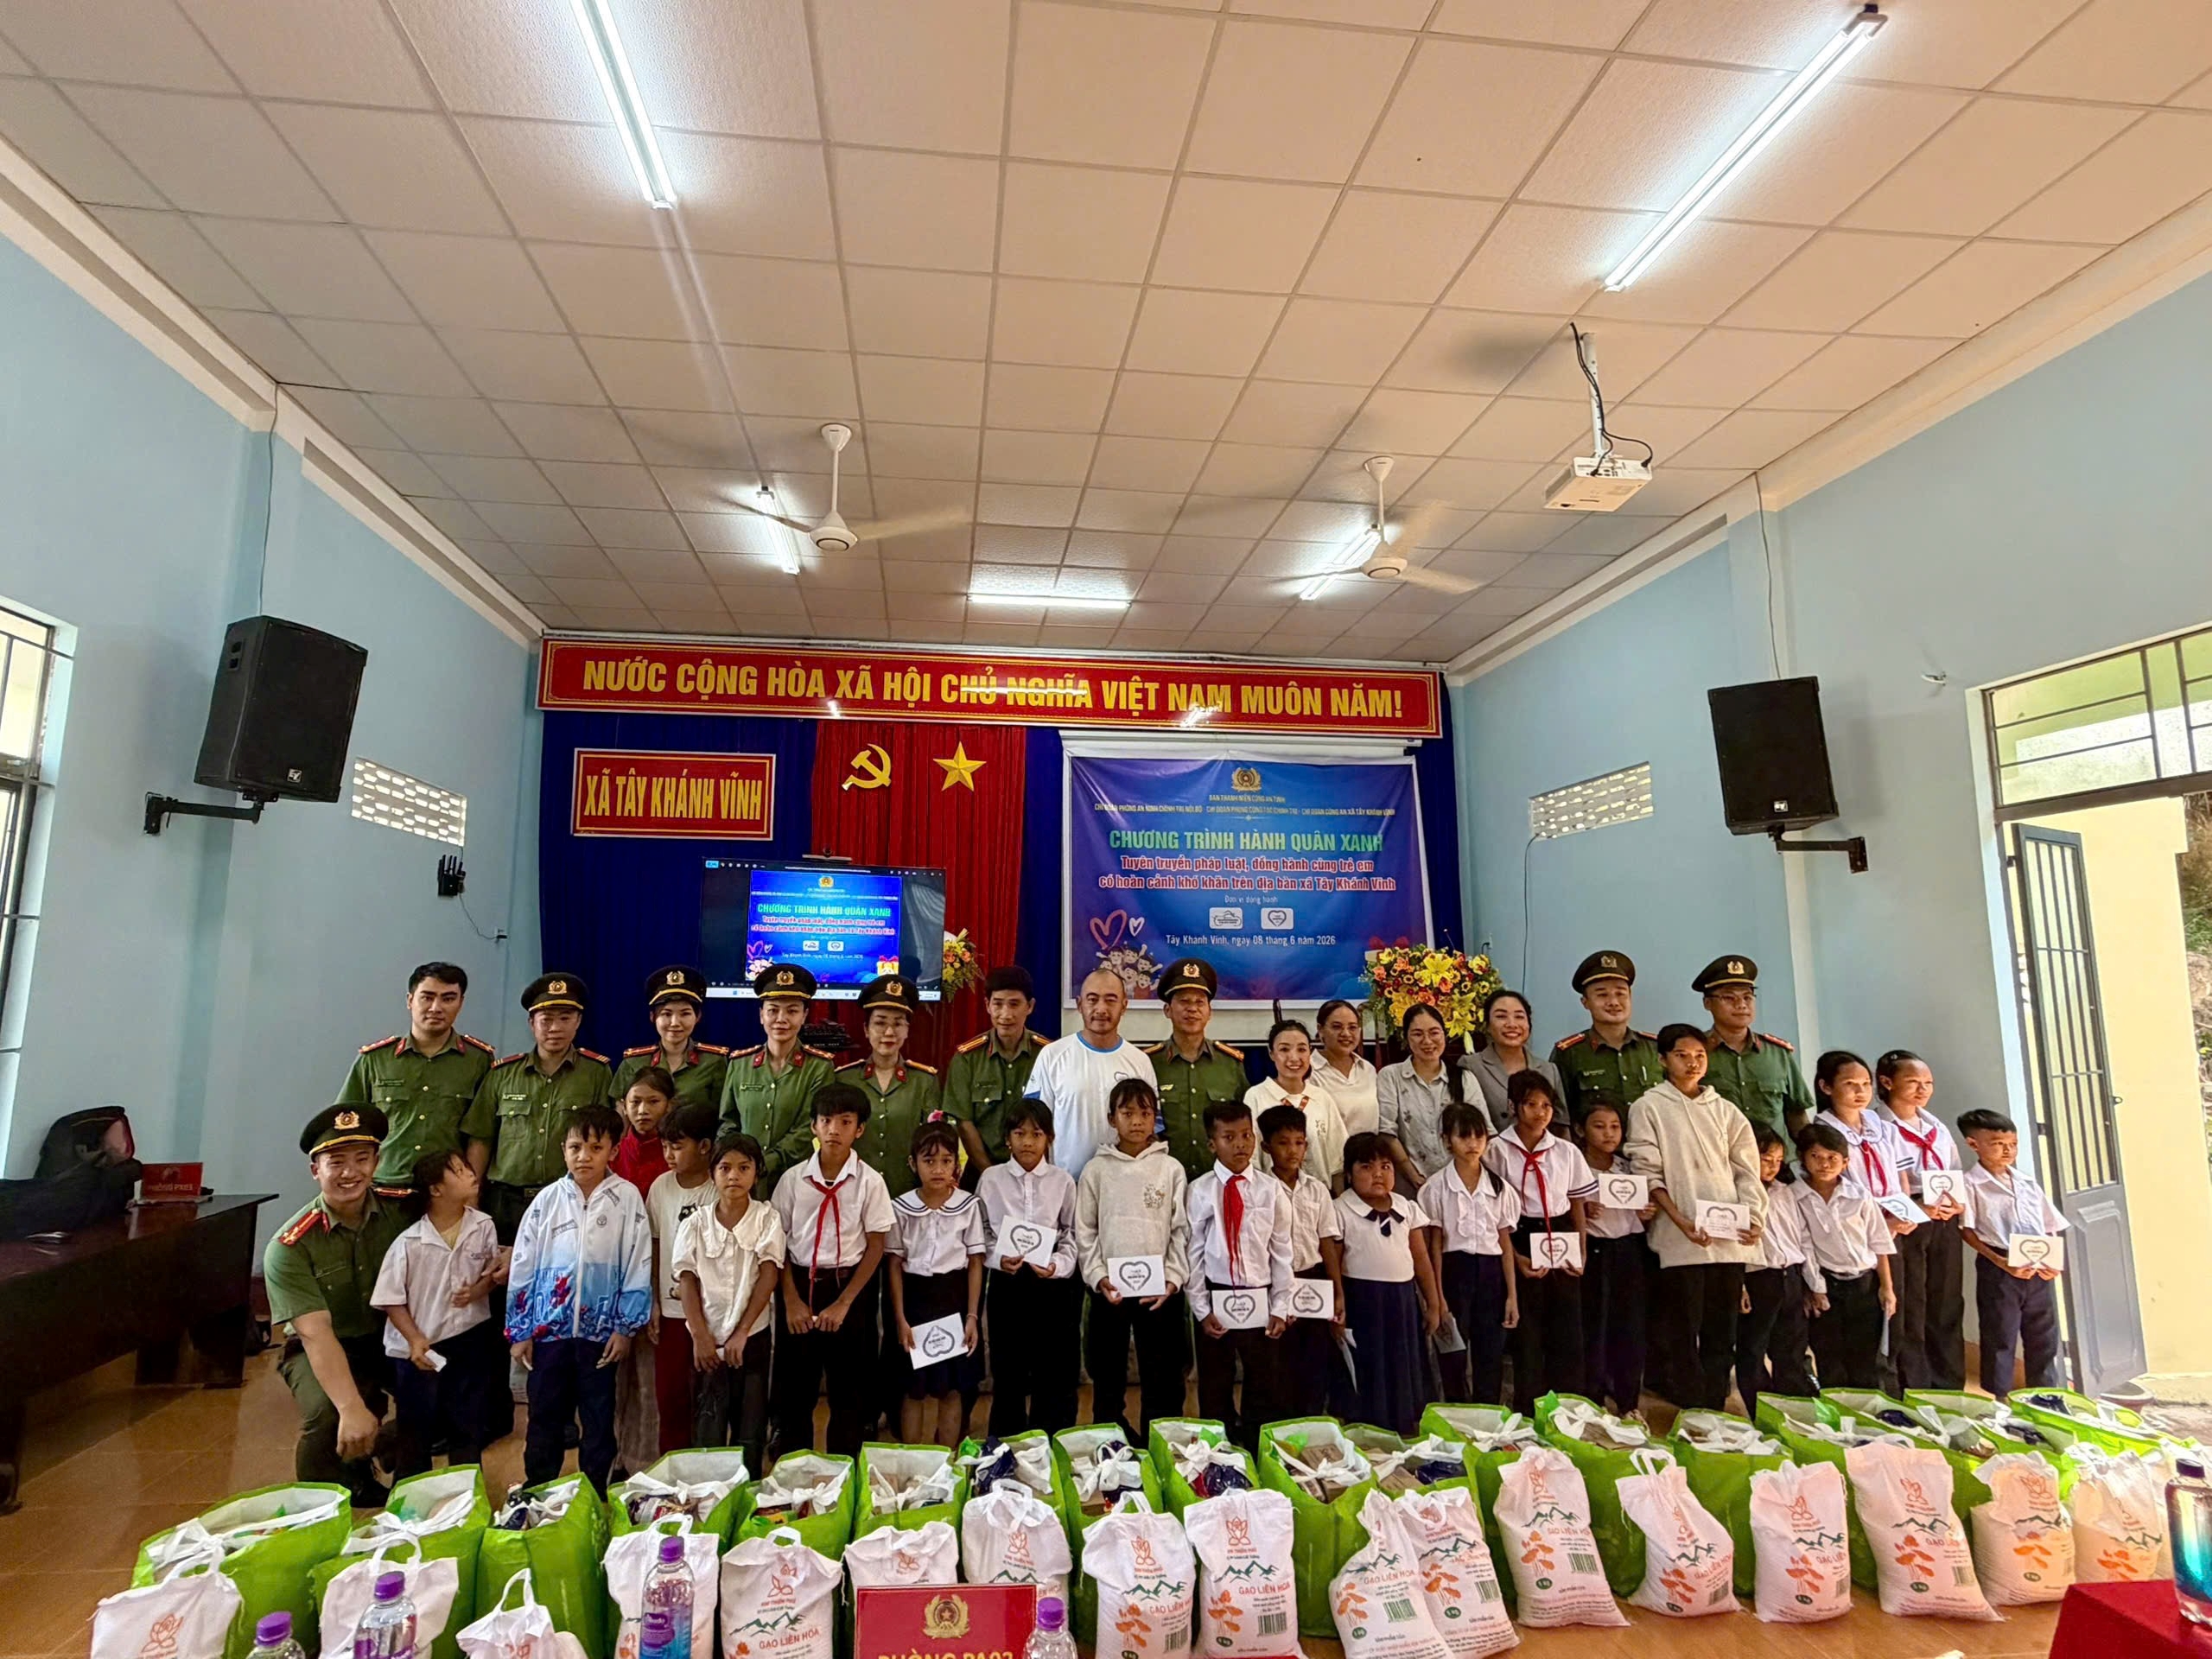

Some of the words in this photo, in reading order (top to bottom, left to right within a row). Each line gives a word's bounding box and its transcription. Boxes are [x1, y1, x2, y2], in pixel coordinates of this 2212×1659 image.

[583, 656, 667, 692] NƯỚC
[676, 658, 758, 701] CỘNG
[766, 661, 823, 699] HÒA
[835, 664, 874, 700] XÃ
[883, 666, 931, 708] HỘI
[941, 666, 997, 706] CHỦ
[1007, 673, 1093, 709] NGHĨA
[1102, 676, 1160, 716] VIỆT
[1168, 683, 1231, 713] NAM
[1241, 681, 1322, 716] MUÔN
[1331, 683, 1402, 719] NĂM!
[584, 768, 611, 817] XÃ
[615, 767, 647, 817] TÂY
[650, 768, 715, 819] KHÁNH
[720, 771, 763, 821] VĨNH
[1109, 830, 1179, 849] CHƯƠNG
[1184, 828, 1235, 850] TRÌNH
[1239, 829, 1287, 851] HÀNH
[1291, 830, 1337, 853] QUÂN
[1340, 833, 1382, 852] XANH
[1121, 855, 1153, 871] Tuyên
[1156, 854, 1191, 871] truyền
[1194, 856, 1222, 872] pháp
[1282, 857, 1310, 872] hành
[1312, 858, 1338, 874] cùng
[1357, 860, 1375, 873] em
[1099, 874, 1115, 888] có
[1116, 874, 1145, 889] hoàn
[1147, 873, 1176, 889] cảnh
[1178, 874, 1198, 889] khó
[1231, 875, 1254, 890] trên
[1256, 876, 1274, 893] địa
[1276, 876, 1297, 891] bàn
[1316, 877, 1335, 892] Tây
[1336, 876, 1370, 892] Khánh
[1253, 935, 1263, 945] 08
[1290, 935, 1295, 945] 6
[1316, 935, 1336, 945] 2026
